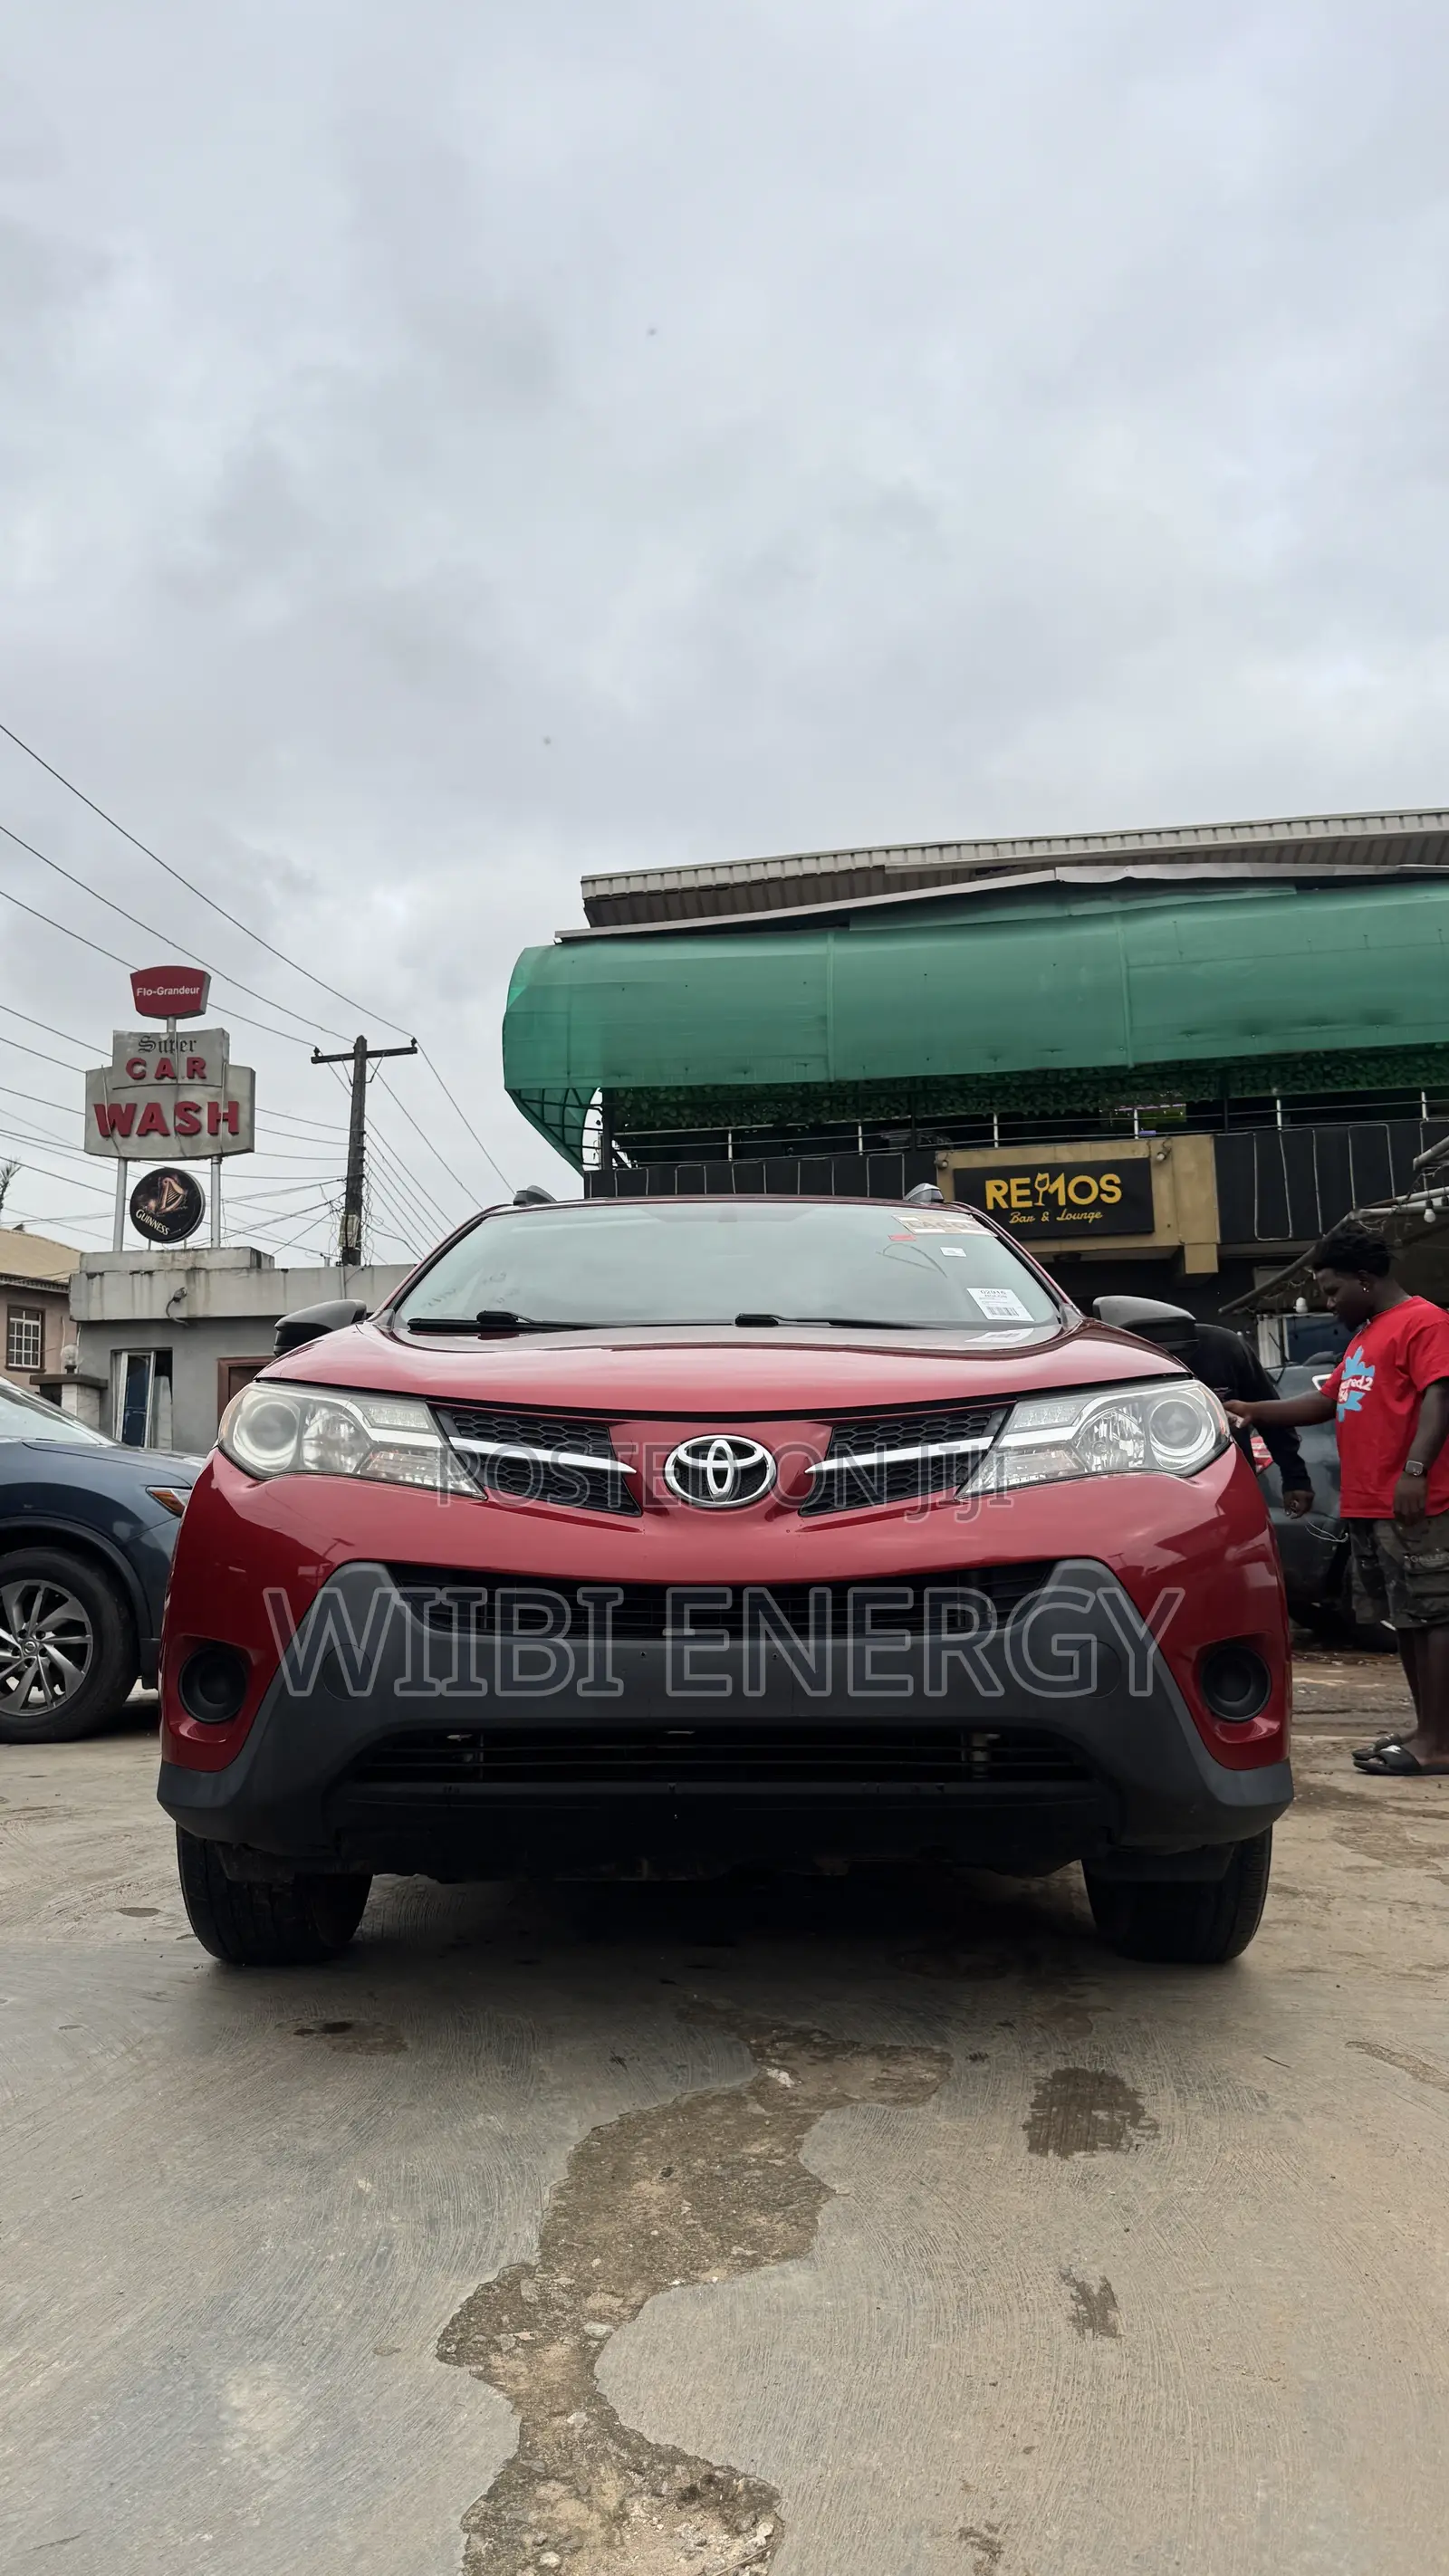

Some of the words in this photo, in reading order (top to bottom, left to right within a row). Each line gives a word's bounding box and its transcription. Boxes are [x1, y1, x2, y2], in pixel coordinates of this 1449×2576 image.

[136, 985, 200, 997] Flo-Grandeur
[138, 1035, 197, 1055] Super
[126, 1057, 207, 1080] CAR
[93, 1100, 240, 1138] WASH
[985, 1173, 1122, 1210] REMOS
[135, 1209, 170, 1236] GUINNESS
[1009, 1211, 1036, 1224] Bar
[1041, 1211, 1050, 1222] &
[1056, 1209, 1103, 1224] Lounge
